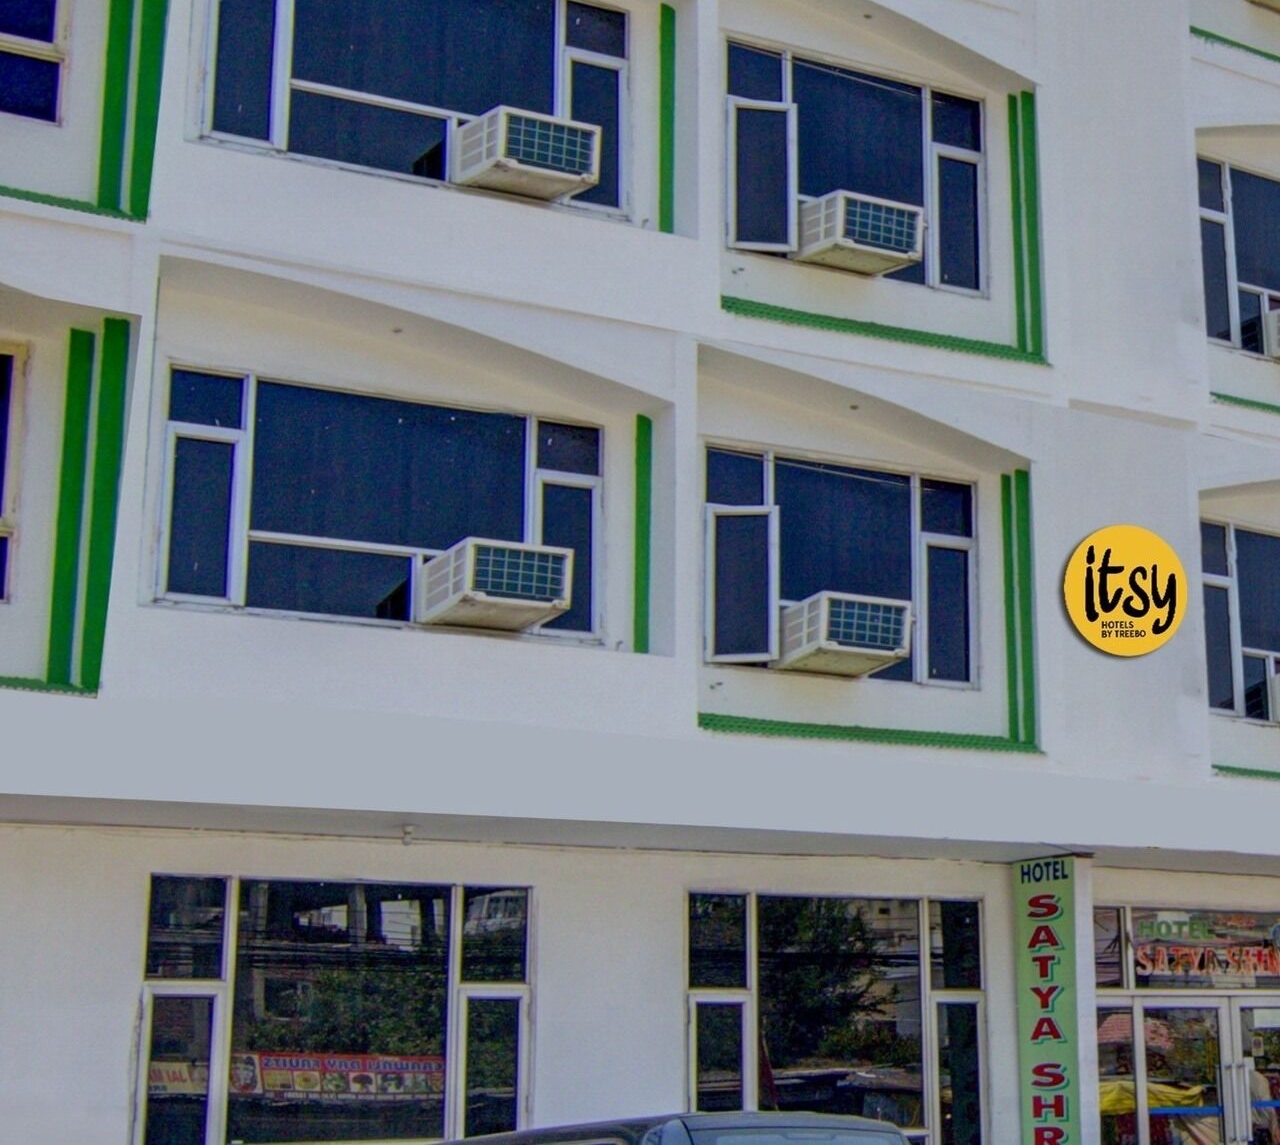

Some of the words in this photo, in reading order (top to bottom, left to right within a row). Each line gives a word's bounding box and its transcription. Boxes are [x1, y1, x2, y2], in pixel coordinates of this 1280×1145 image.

[1085, 545, 1177, 635] itsy
[1101, 620, 1135, 629] HOTELS
[1101, 629, 1113, 639] BY
[1115, 629, 1147, 639] TREEBO
[1020, 860, 1069, 884] HOTEL
[1138, 920, 1216, 940] HOTEL
[1027, 894, 1066, 1043] SATYA
[1135, 944, 1220, 977] SATYA
